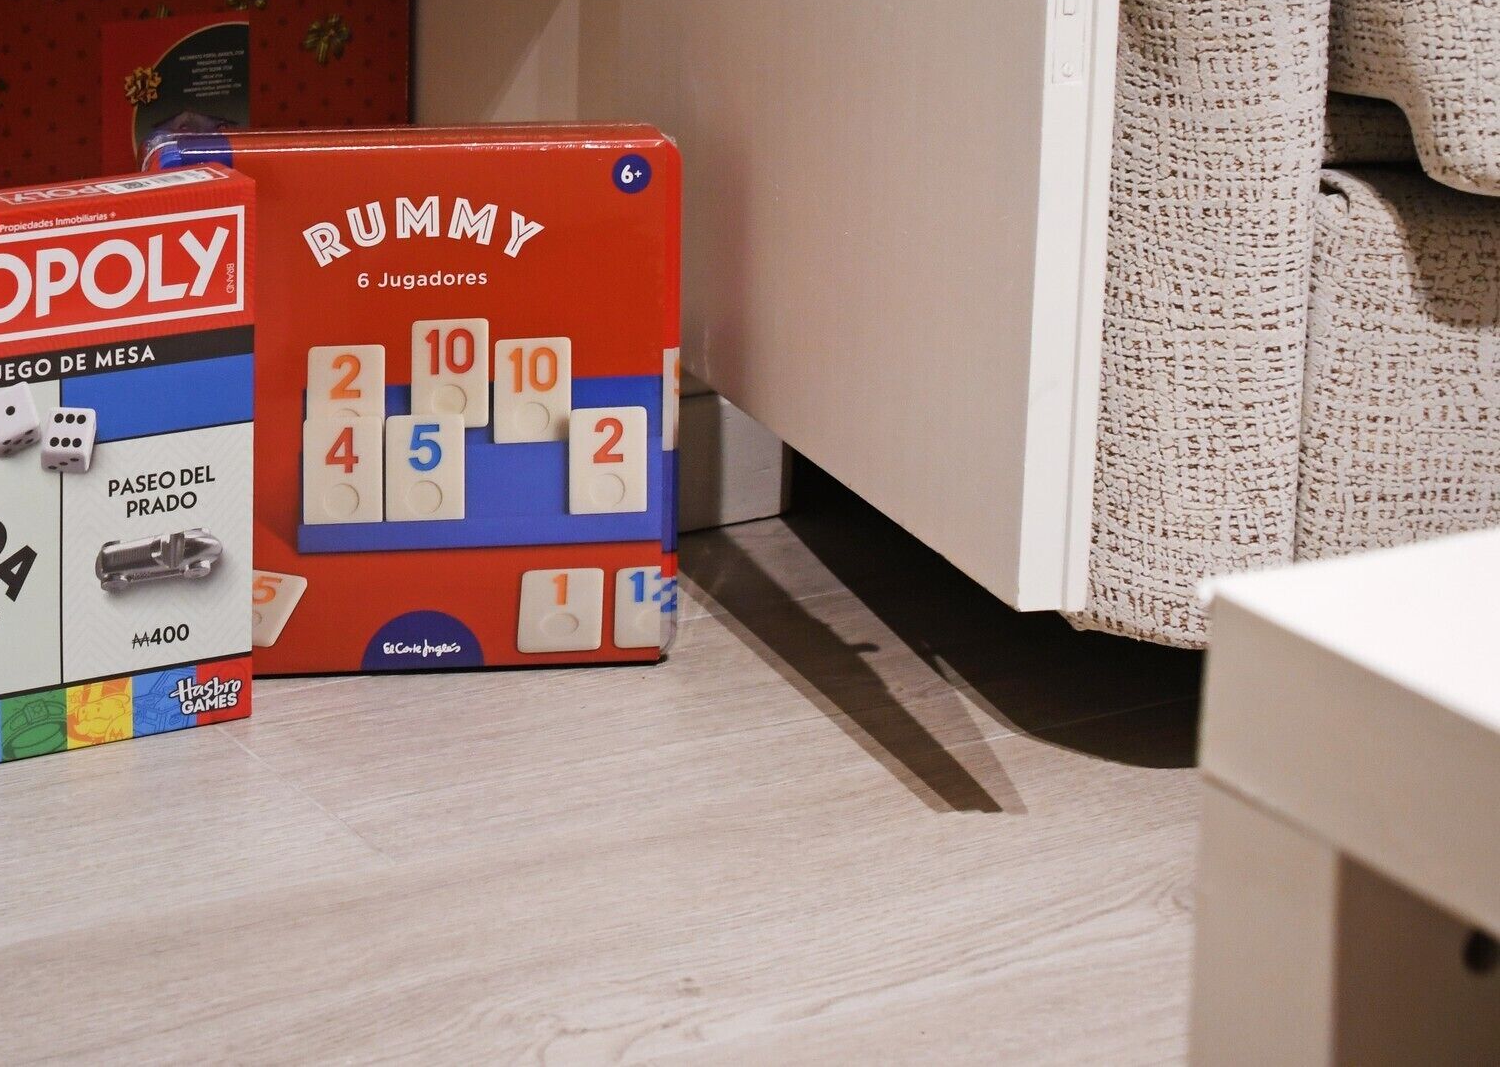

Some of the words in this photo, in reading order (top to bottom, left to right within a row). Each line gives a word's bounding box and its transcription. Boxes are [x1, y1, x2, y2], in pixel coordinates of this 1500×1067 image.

[620, 164, 642, 185] 6+
[0, 218, 54, 234] Propiedades
[55, 212, 108, 227] Inmobiliarias
[302, 195, 545, 269] RUMMY
[225, 262, 235, 294] BRAND
[356, 273, 370, 289] 6
[377, 269, 488, 291] Jugadores
[59, 352, 87, 373] DE
[95, 344, 156, 369] MESA
[424, 328, 475, 376] 10
[328, 354, 361, 400] 2
[508, 347, 558, 394] 10
[325, 427, 359, 473] 4
[408, 423, 442, 471] 5
[592, 417, 624, 464] 2
[107, 470, 176, 498] PASEO
[180, 465, 216, 488] DEL
[125, 491, 198, 519] PRADO
[551, 574, 568, 606] 1
[383, 641, 398, 655] El
[397, 641, 423, 655] Corte
[422, 638, 461, 657] Inglés
[170, 677, 242, 703] Hasbro
[181, 691, 238, 715] GAMES
